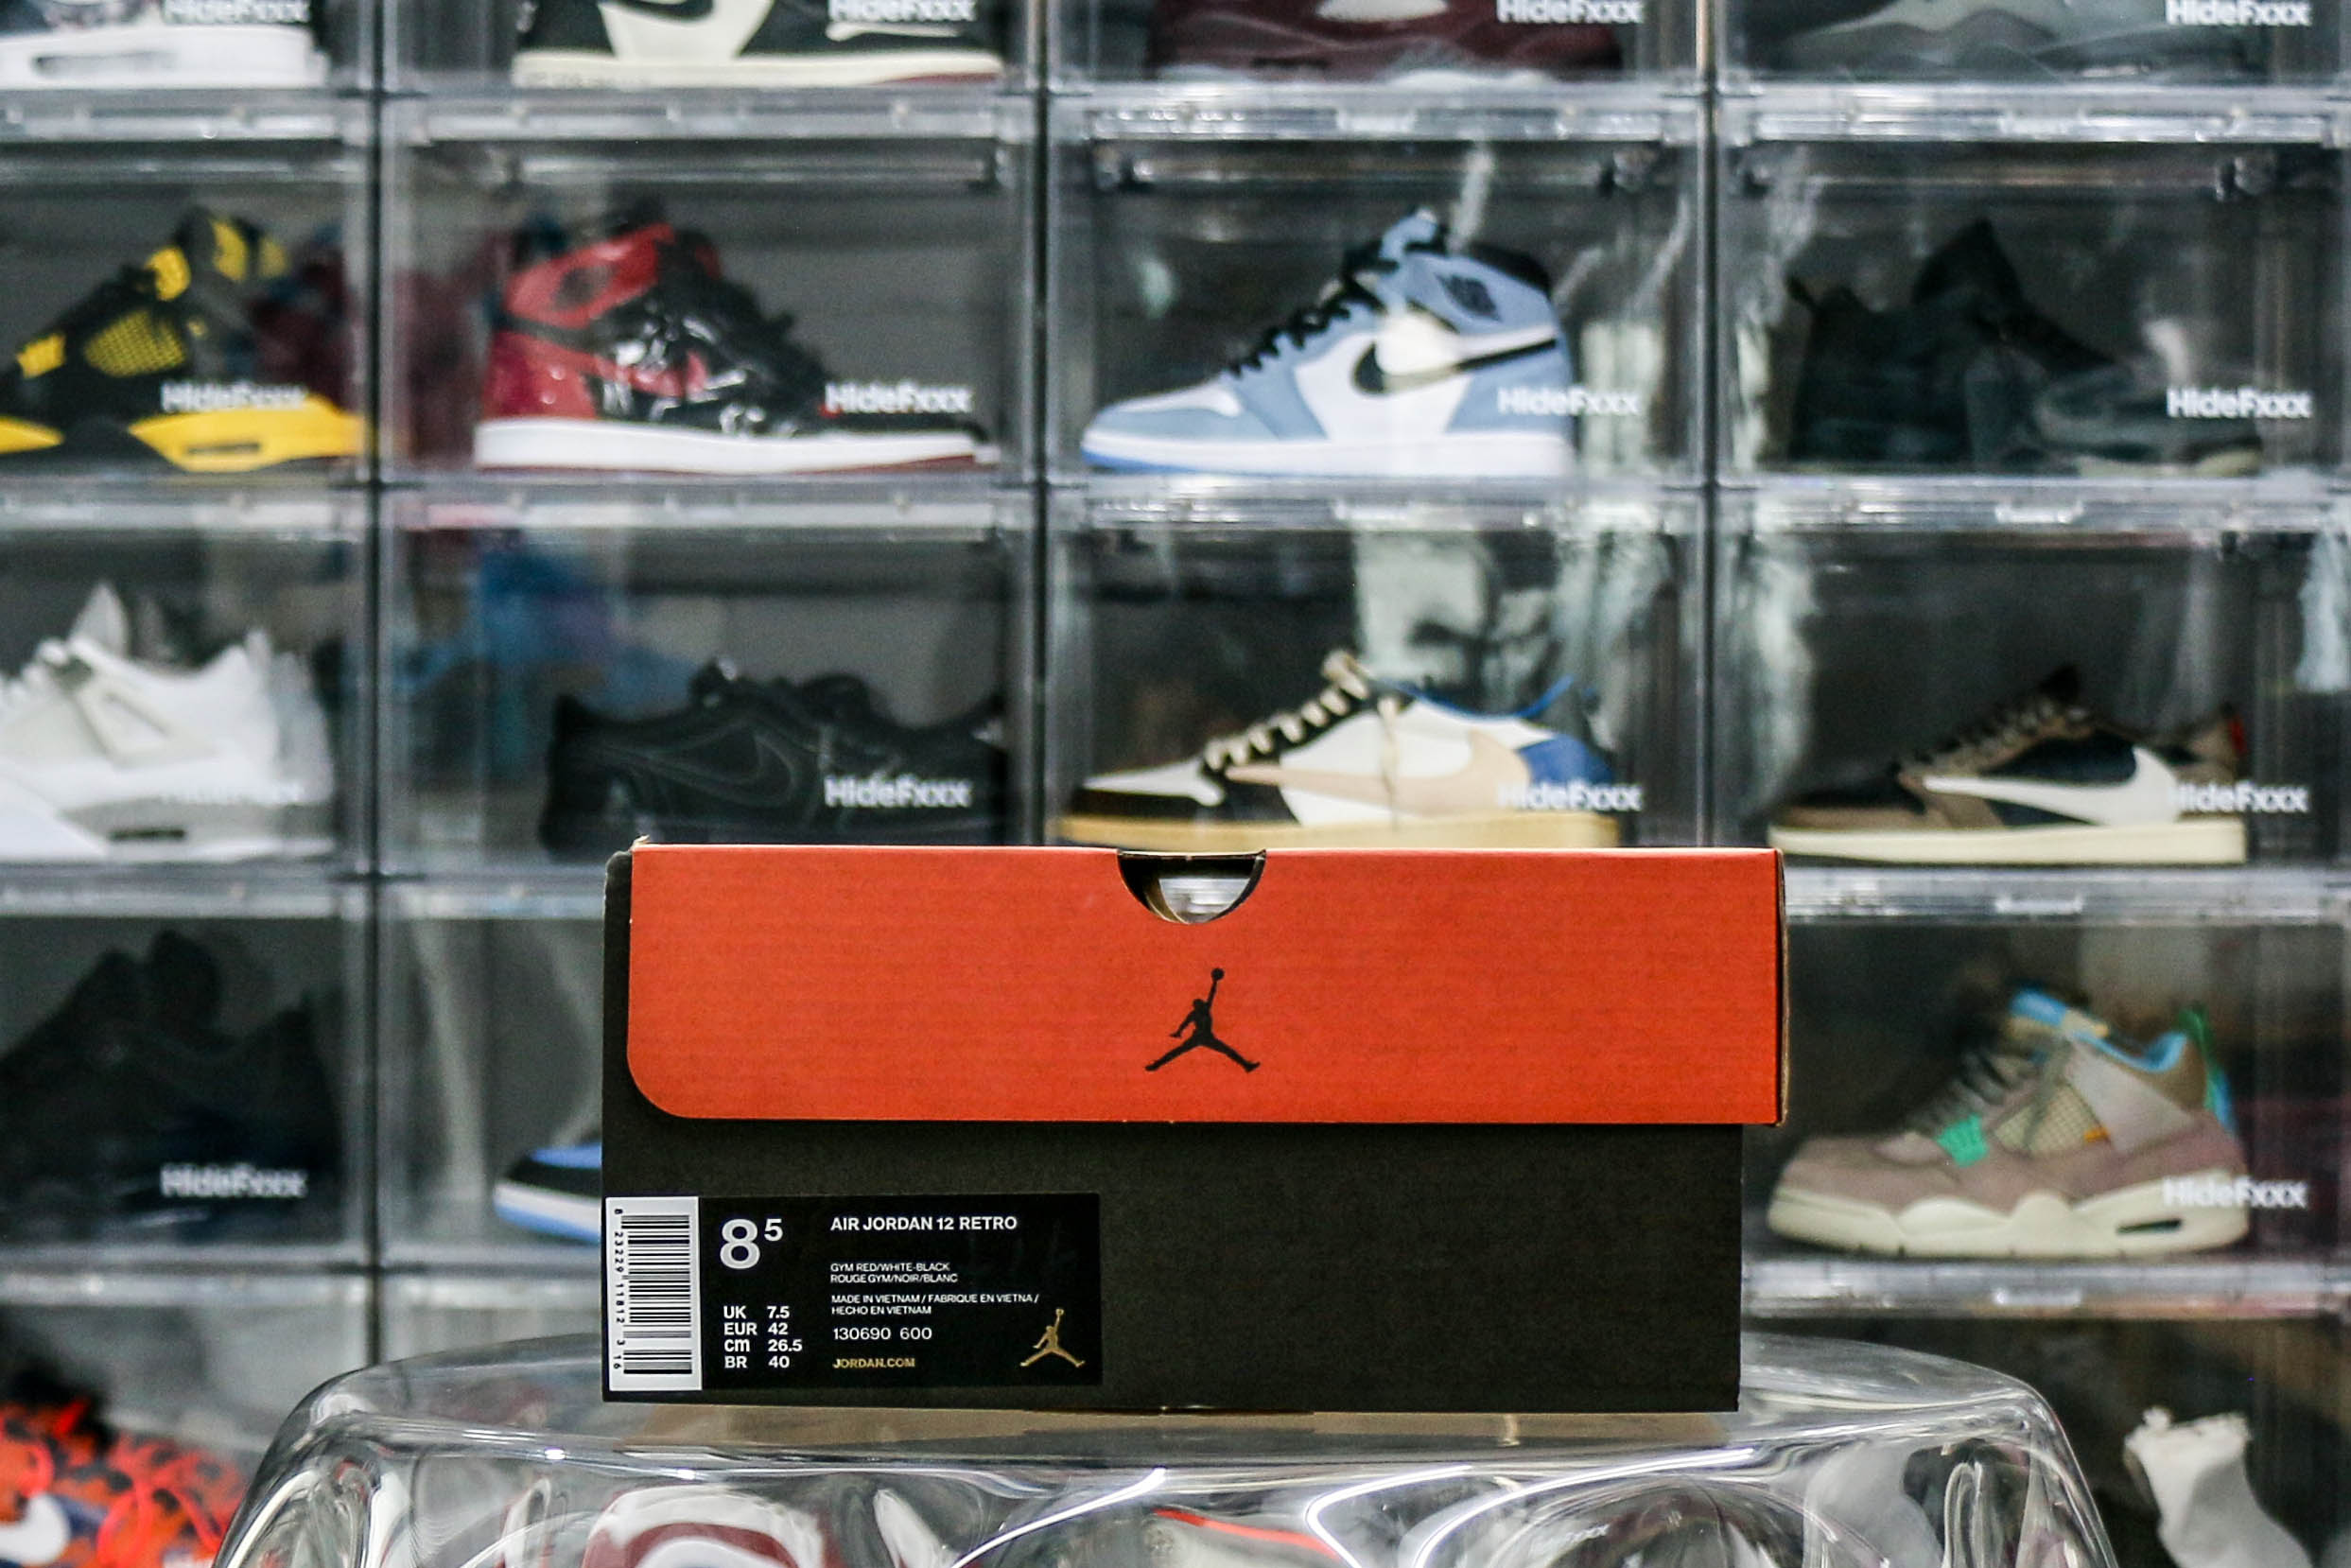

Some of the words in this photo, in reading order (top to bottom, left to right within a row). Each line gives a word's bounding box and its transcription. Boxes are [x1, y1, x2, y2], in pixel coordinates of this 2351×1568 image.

[826, 382, 973, 412] HideFxxx
[1497, 384, 1643, 415] HideFxxx
[2167, 387, 2312, 418] HideFxxx
[825, 775, 972, 808] HideFxxx
[830, 1217, 860, 1230] AIR
[862, 1217, 933, 1230] JORDAN
[936, 1217, 954, 1229] 12
[959, 1216, 1018, 1230] RETRO
[720, 1219, 761, 1269] 8
[764, 1218, 783, 1242] 5
[830, 1263, 854, 1272] GYM
[856, 1263, 950, 1272] RED/WHITE-BLACK
[830, 1274, 867, 1283] ROUGE
[867, 1274, 958, 1283] GYM/NOIR/BLANC
[831, 1295, 860, 1304] MADE
[862, 1295, 874, 1303] IN
[875, 1295, 920, 1303] VIETNAM
[928, 1294, 978, 1304] FABRIQUE
[980, 1294, 994, 1303] EN
[996, 1294, 1033, 1302] VIETNA
[723, 1305, 746, 1319] UK
[767, 1305, 791, 1319] 7.5
[831, 1306, 868, 1315] HECHO
[870, 1306, 885, 1315] EN
[886, 1306, 932, 1315] VIETNAM
[723, 1322, 758, 1336] EUR
[767, 1322, 789, 1336] 42
[833, 1327, 892, 1341] 130690
[899, 1327, 932, 1340] 600
[724, 1338, 751, 1353] cm
[767, 1339, 803, 1353] 26.5
[724, 1355, 748, 1369] BR
[768, 1355, 791, 1369] 40
[832, 1357, 916, 1368] JORDAN.COM
